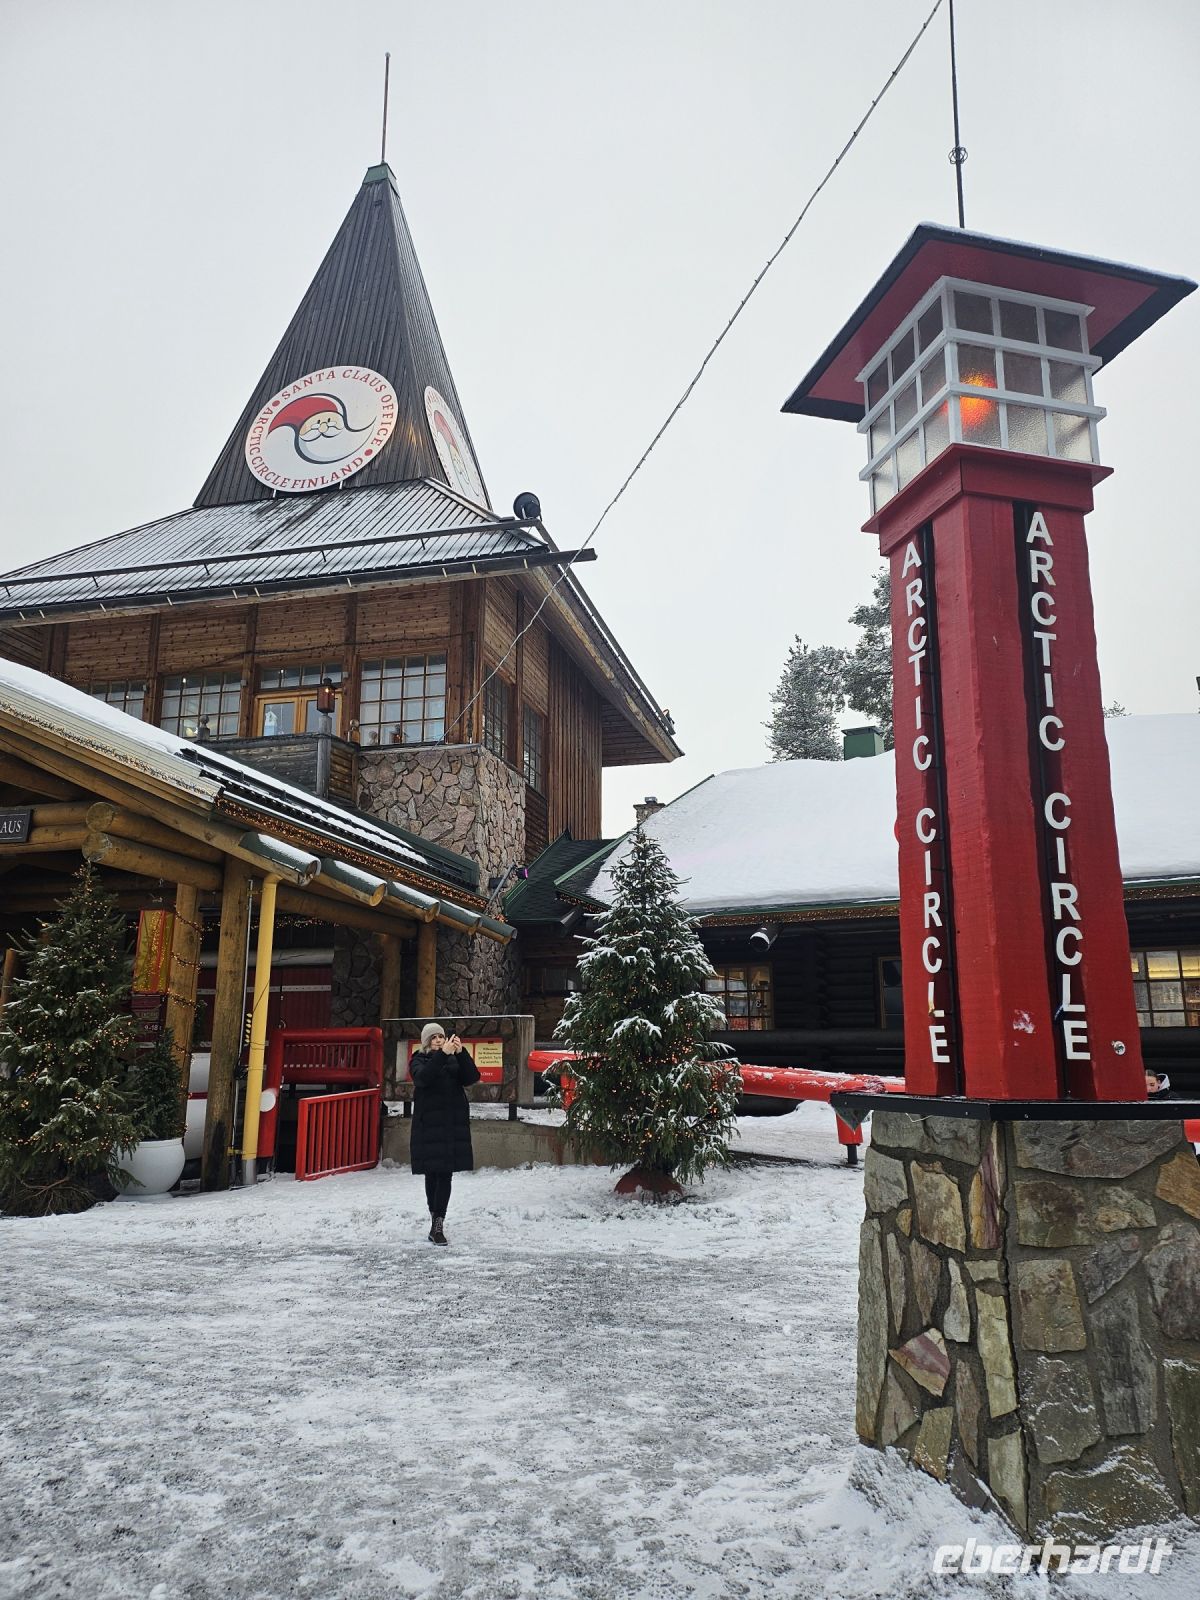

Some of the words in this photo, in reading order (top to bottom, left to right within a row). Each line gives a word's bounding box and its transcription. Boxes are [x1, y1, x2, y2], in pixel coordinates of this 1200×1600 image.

[249, 406, 274, 455] ARCTIC
[251, 456, 290, 488] CIRCLE
[281, 370, 336, 400] SANTA
[342, 369, 387, 393] CLAUS
[371, 394, 394, 446] OFFICE
[291, 457, 364, 489] FINLAND
[901, 541, 932, 771] ARCTIC
[1026, 511, 1066, 751] ARCTIC
[915, 807, 950, 1063] CIRCLE
[1044, 792, 1091, 1060] CIRCLE
